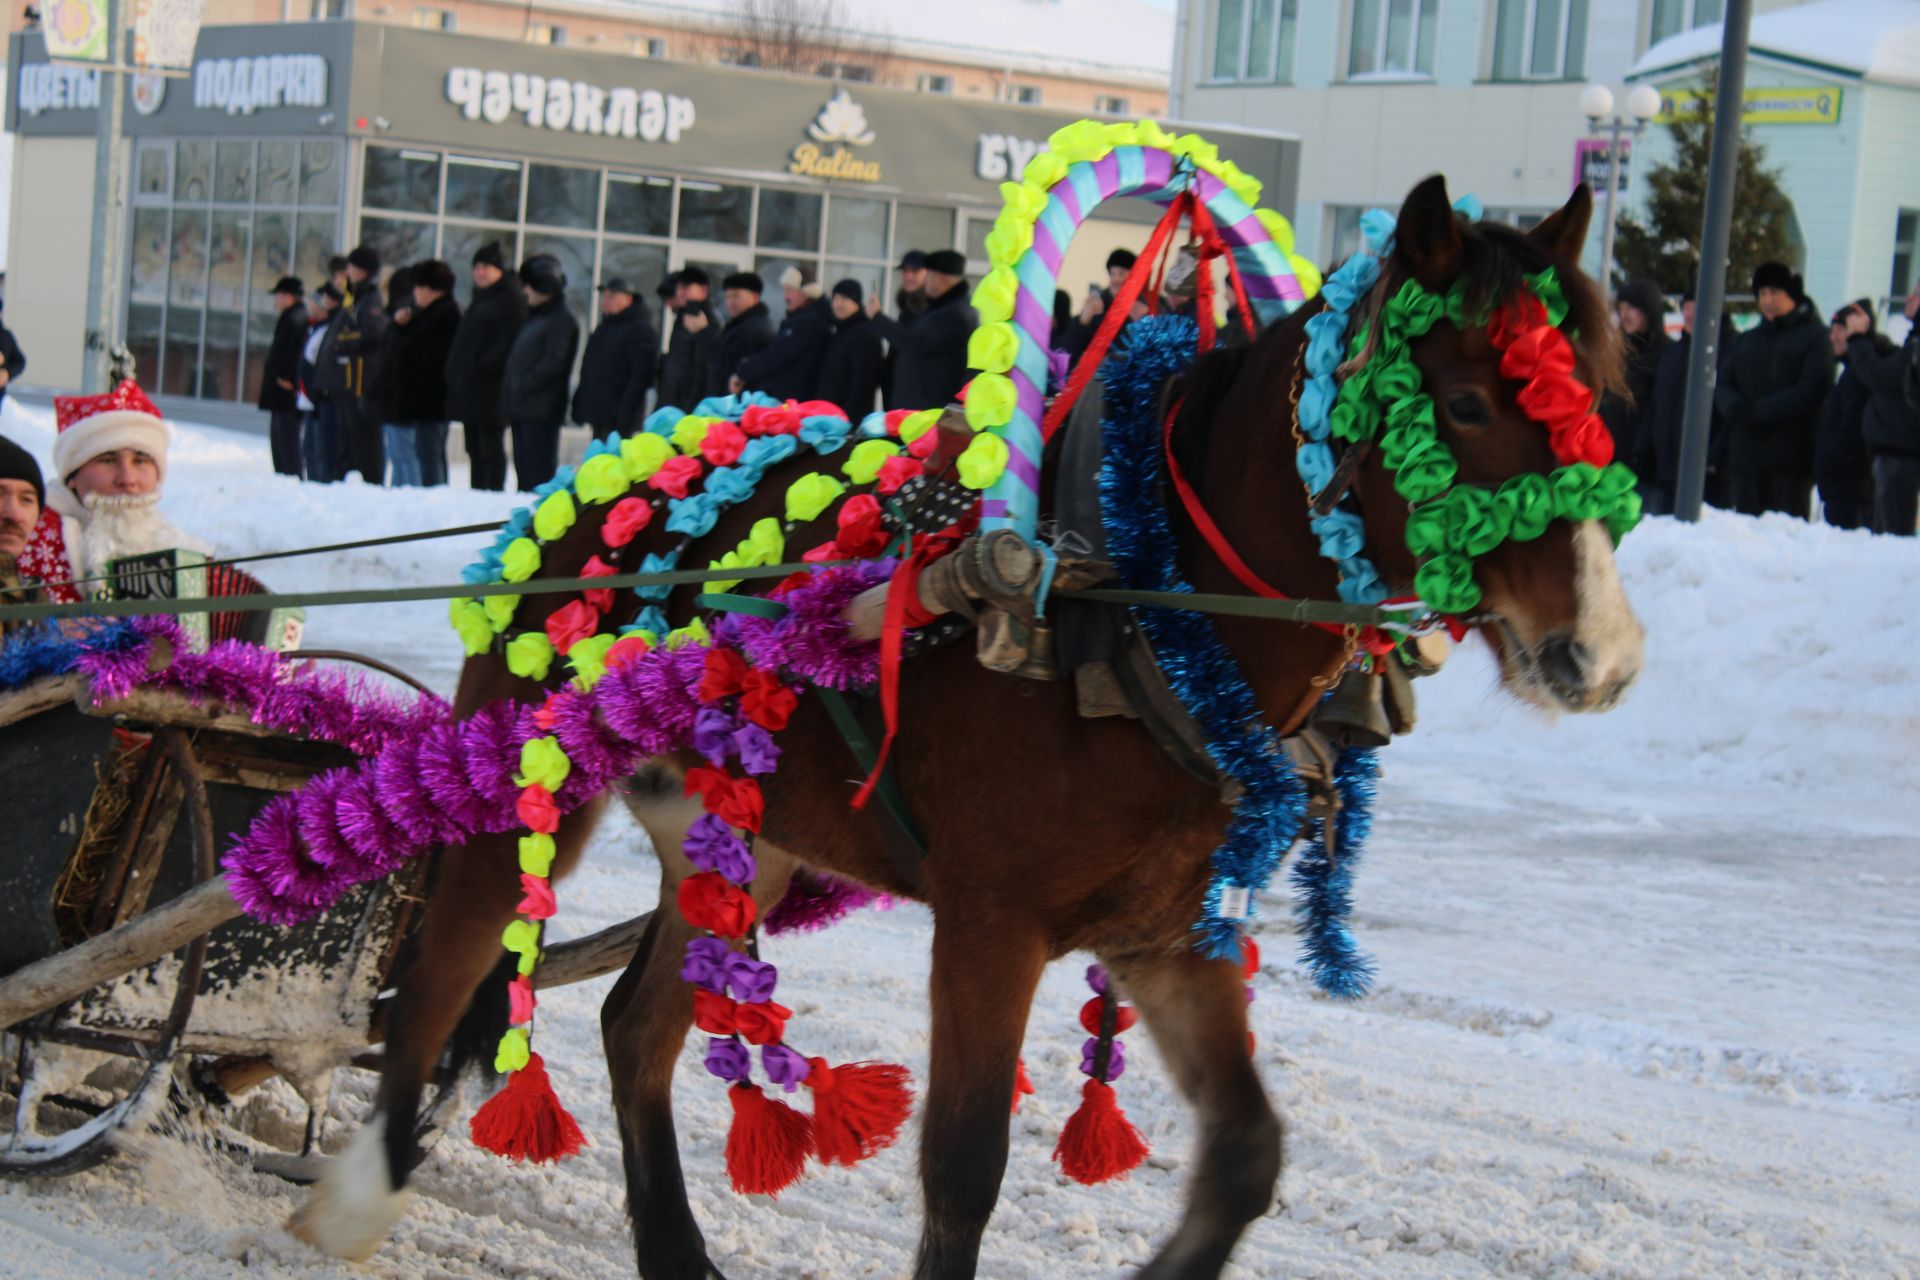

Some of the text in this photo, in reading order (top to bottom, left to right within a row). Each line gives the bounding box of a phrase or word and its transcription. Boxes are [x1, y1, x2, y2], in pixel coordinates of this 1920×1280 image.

[20, 63, 100, 116] ЦВЕТЫ
[194, 55, 328, 115] ПОДАРКИ
[979, 133, 1050, 182] БУ
